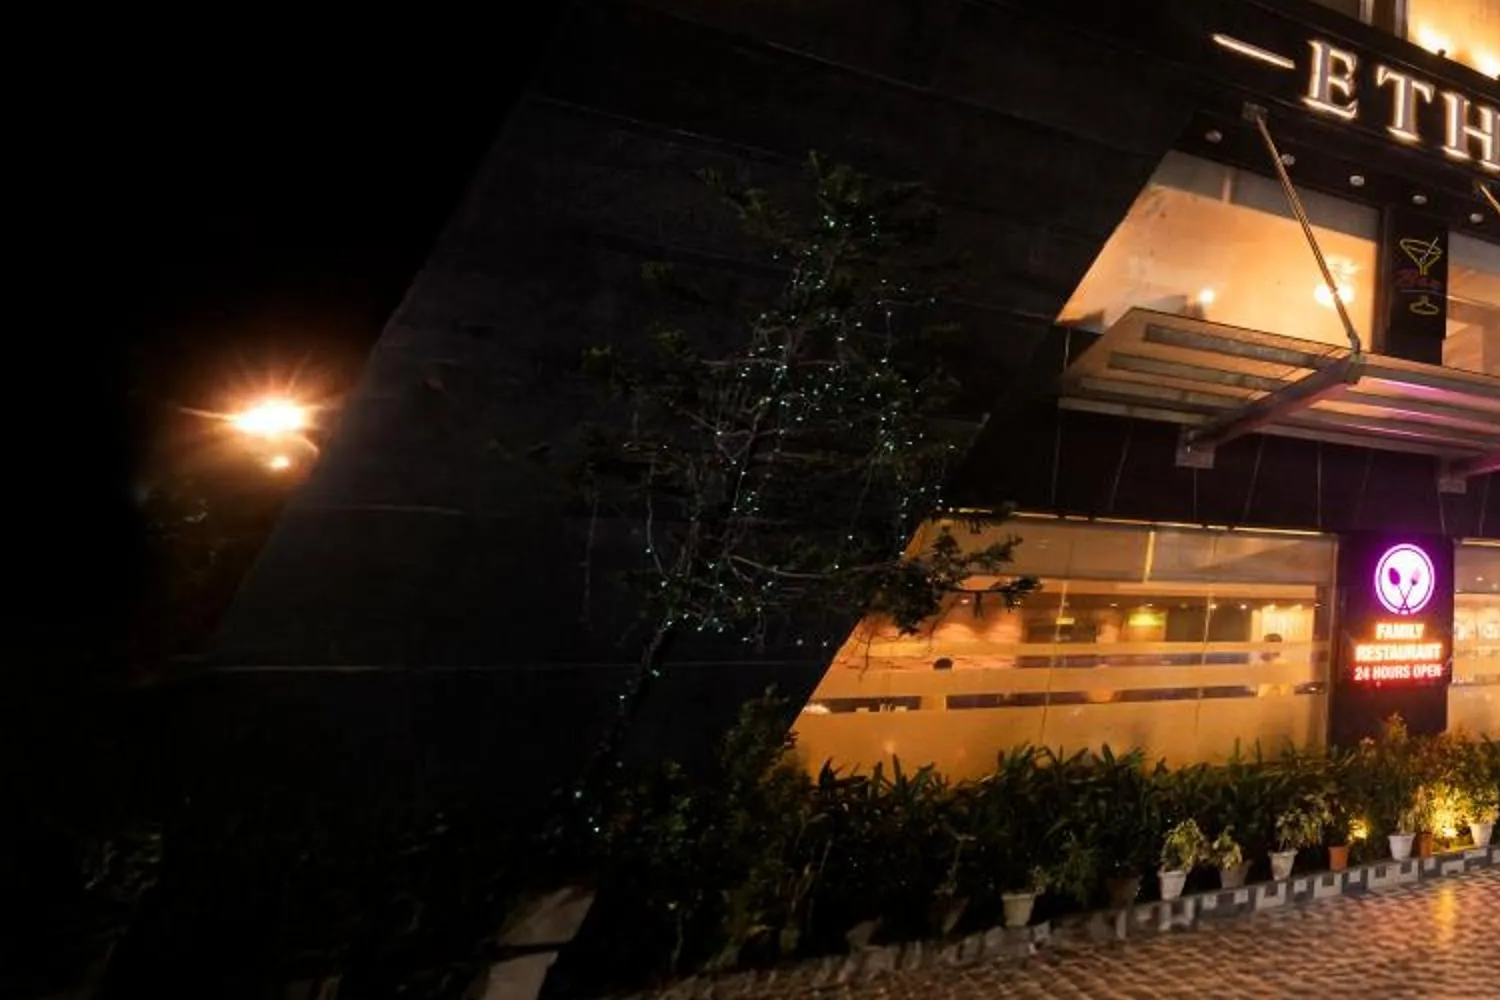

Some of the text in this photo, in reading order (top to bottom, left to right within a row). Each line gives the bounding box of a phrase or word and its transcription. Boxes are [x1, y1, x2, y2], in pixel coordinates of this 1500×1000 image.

[1375, 622, 1425, 640] FAMILY
[1355, 643, 1443, 662] RESTAURANT
[1354, 663, 1442, 681] 24 HOURS OPEN
